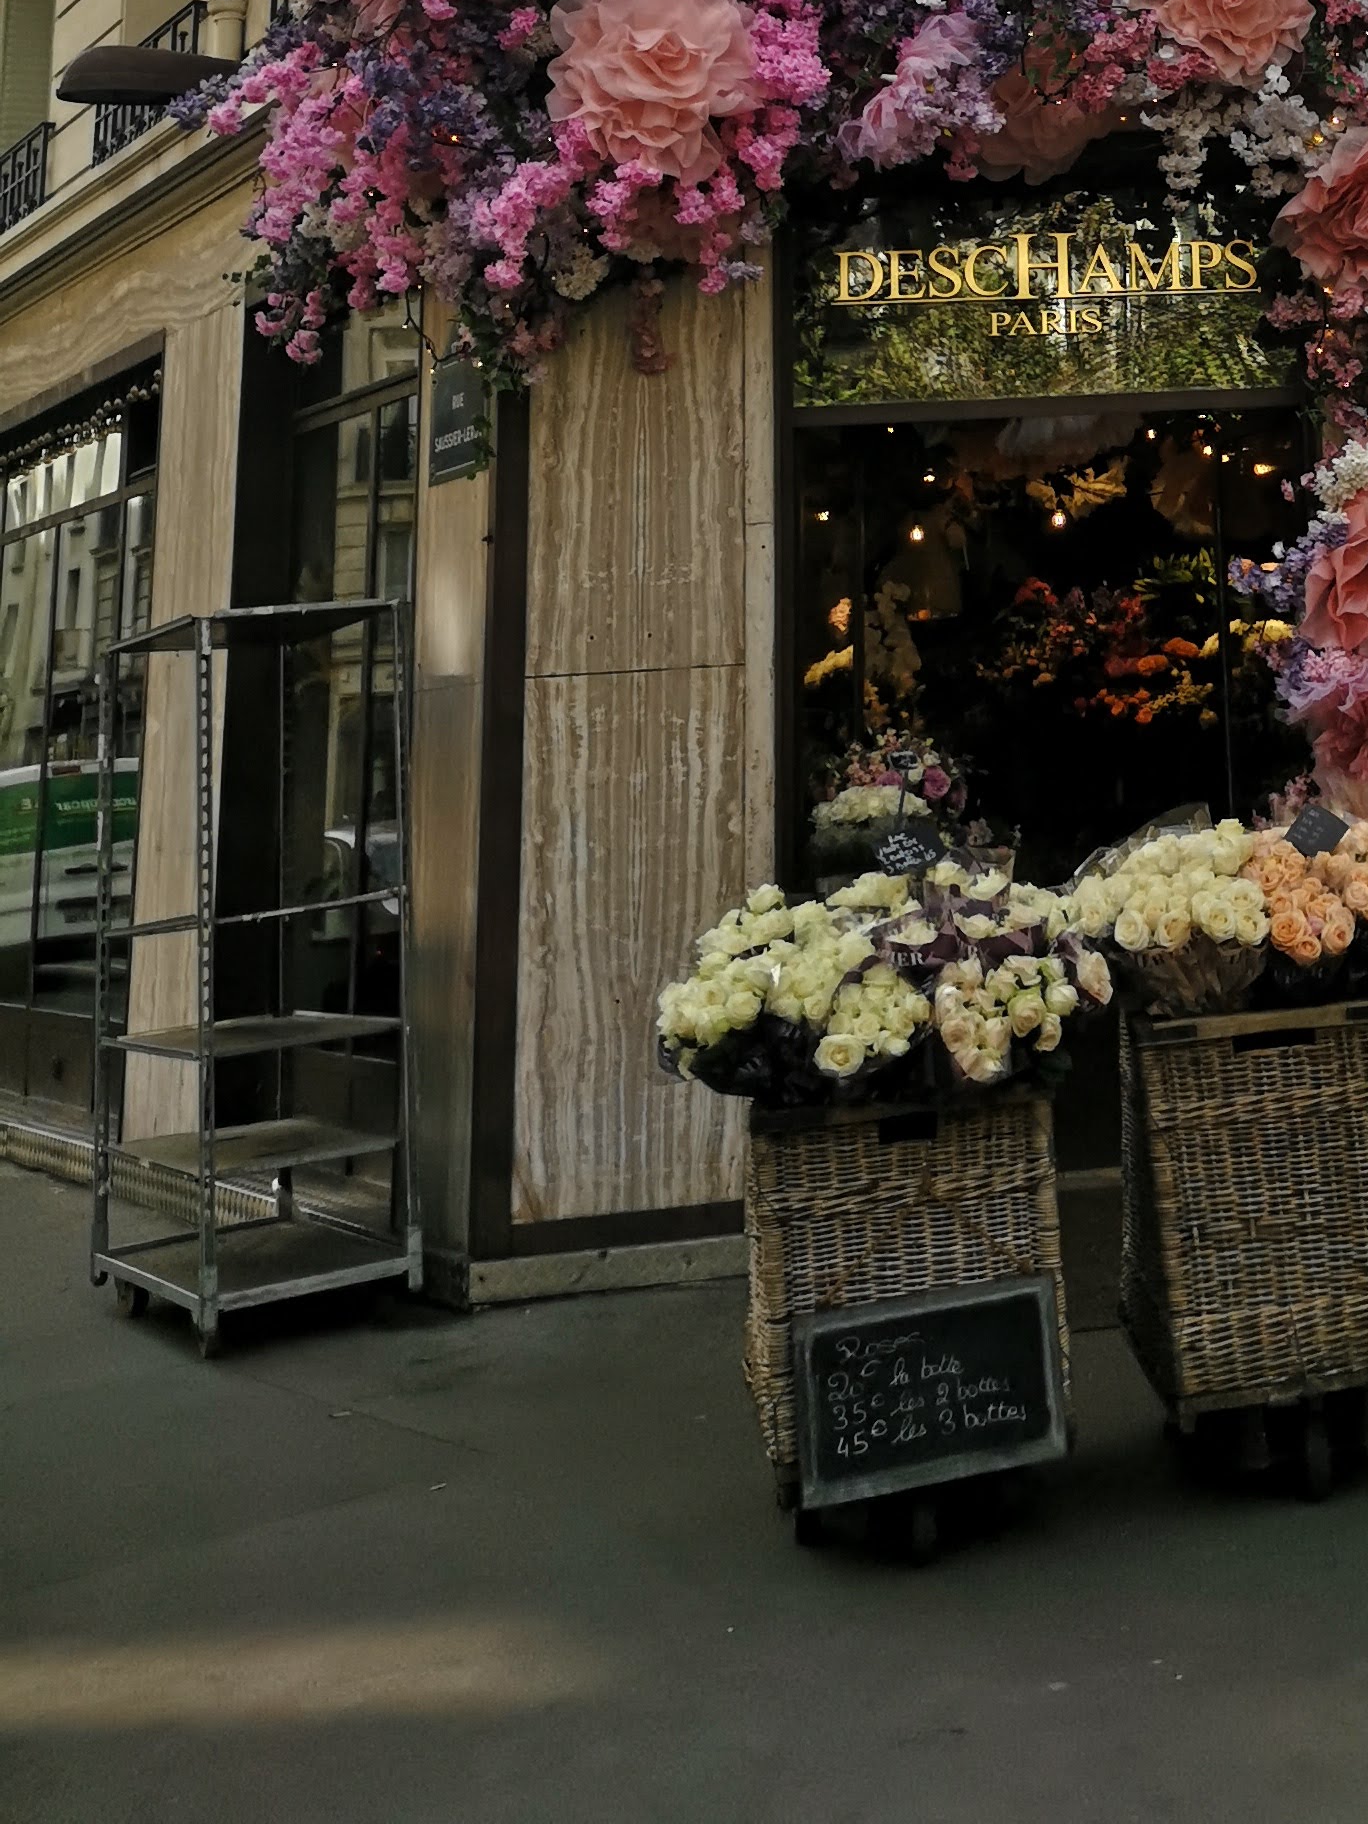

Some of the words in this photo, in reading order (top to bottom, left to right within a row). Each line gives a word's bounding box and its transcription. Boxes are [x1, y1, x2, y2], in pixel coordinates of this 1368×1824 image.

[834, 232, 1259, 301] DESCHAMPS
[989, 307, 1103, 337] PARIS
[451, 392, 465, 410] RUE
[890, 1390, 926, 1418] les
[935, 1382, 951, 1407] 2
[890, 1415, 928, 1446] les
[938, 1408, 956, 1435] 3
